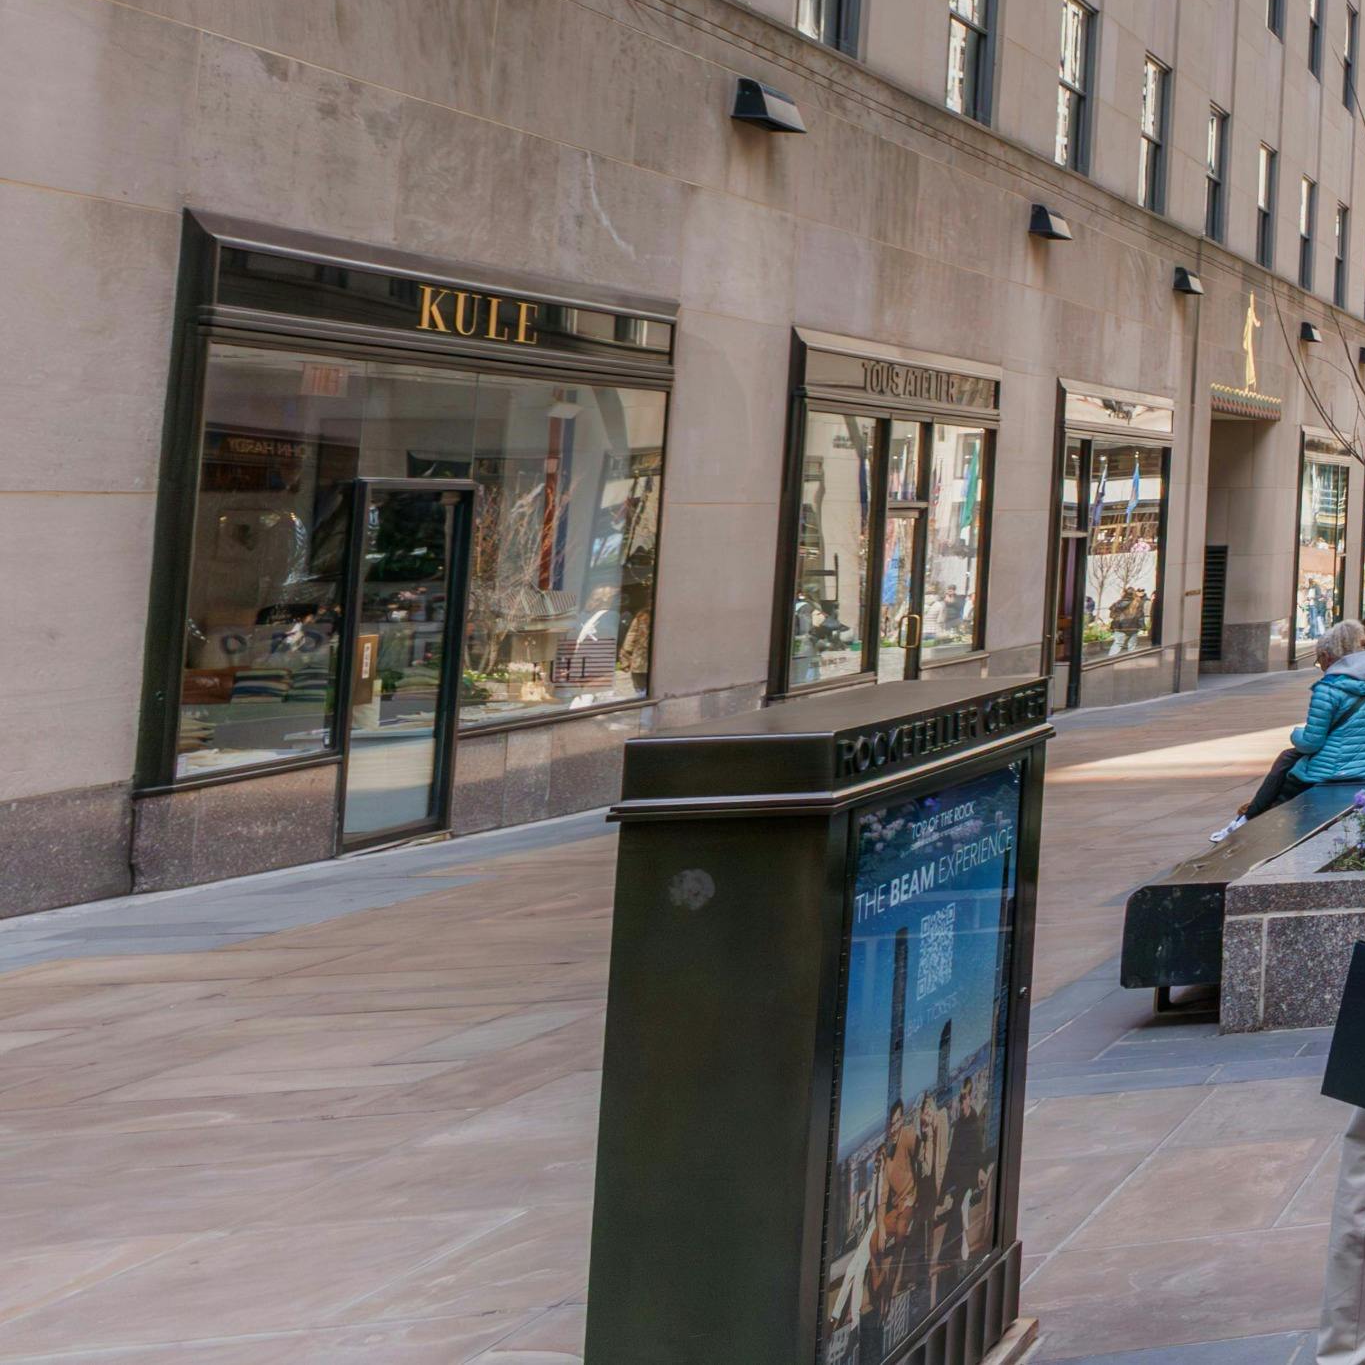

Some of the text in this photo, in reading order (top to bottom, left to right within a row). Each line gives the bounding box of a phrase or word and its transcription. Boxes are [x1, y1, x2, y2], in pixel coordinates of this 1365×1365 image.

[416, 285, 538, 345] KULE
[862, 360, 901, 397] TOUS
[835, 706, 979, 778] ROCKEFELLER
[912, 822, 928, 840] TOP
[928, 815, 940, 833] OF
[940, 808, 954, 827] THE
[954, 800, 977, 822] ROCK
[855, 883, 887, 924] THE
[890, 861, 936, 907] BEAM
[938, 825, 1014, 884] EXPERIENCE
